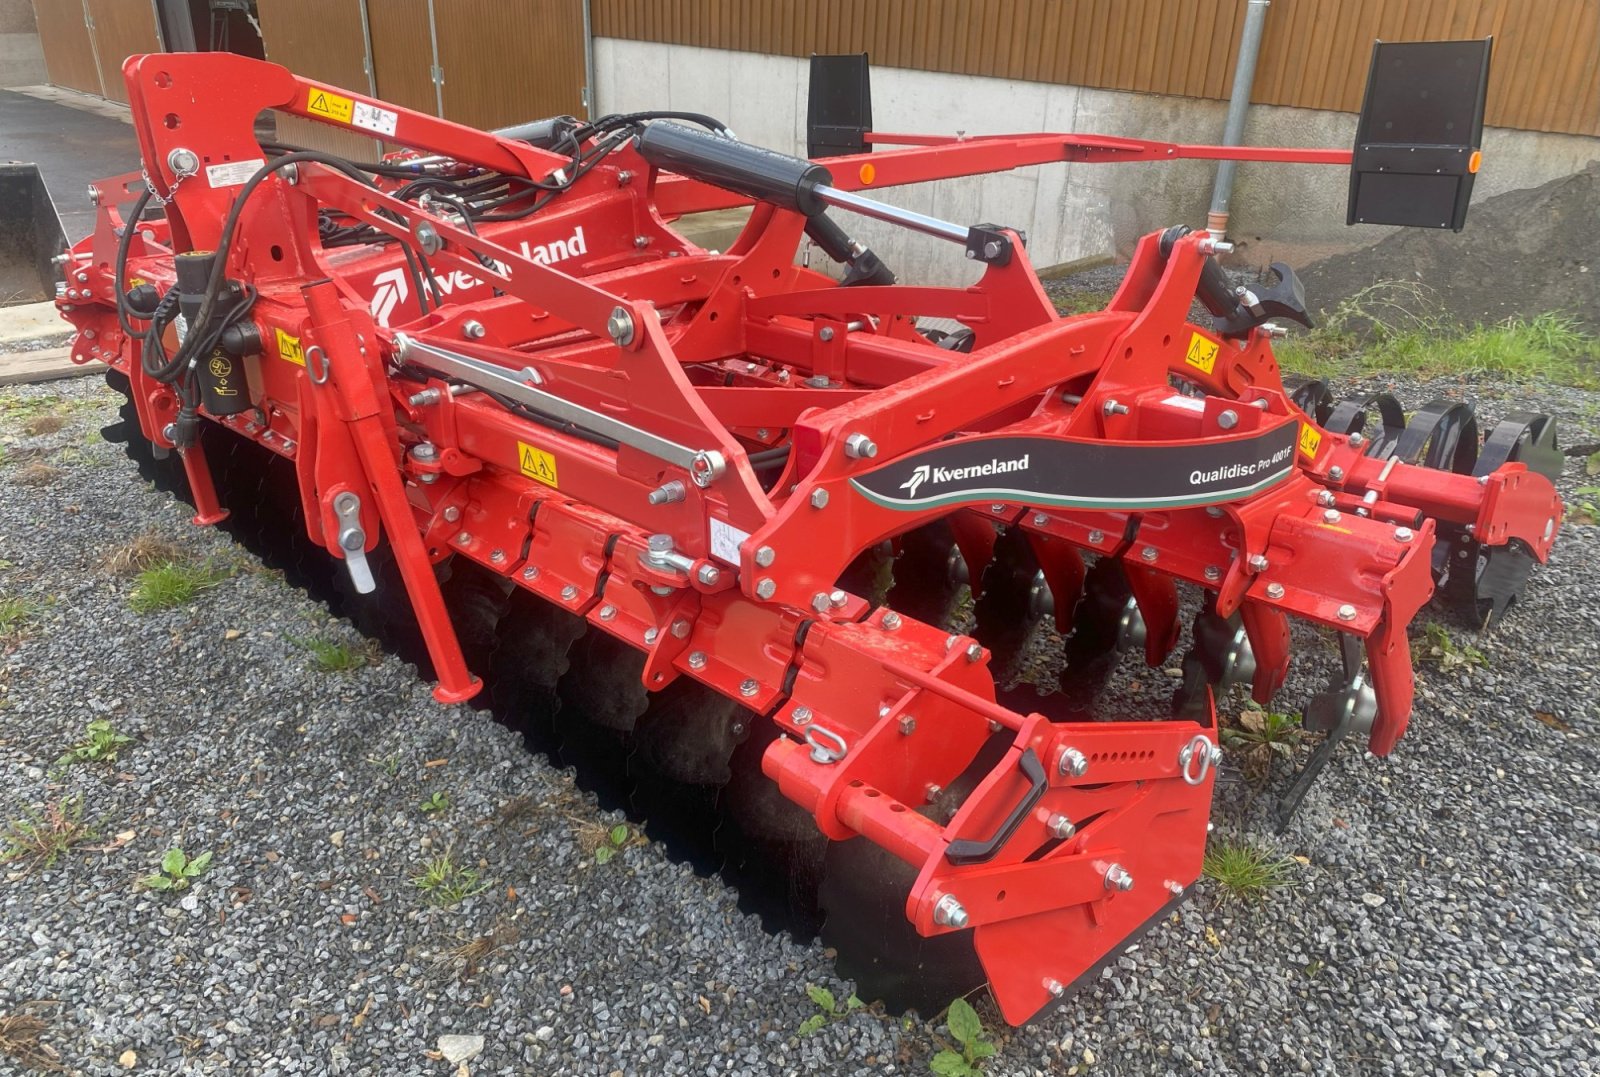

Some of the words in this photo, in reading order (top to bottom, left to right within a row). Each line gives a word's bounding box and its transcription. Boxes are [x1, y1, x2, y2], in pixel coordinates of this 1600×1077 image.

[932, 454, 1029, 483] Kverneland
[1189, 463, 1256, 485] Qualidisc
[1257, 459, 1271, 472] Pro
[1271, 445, 1292, 464] 4001F
